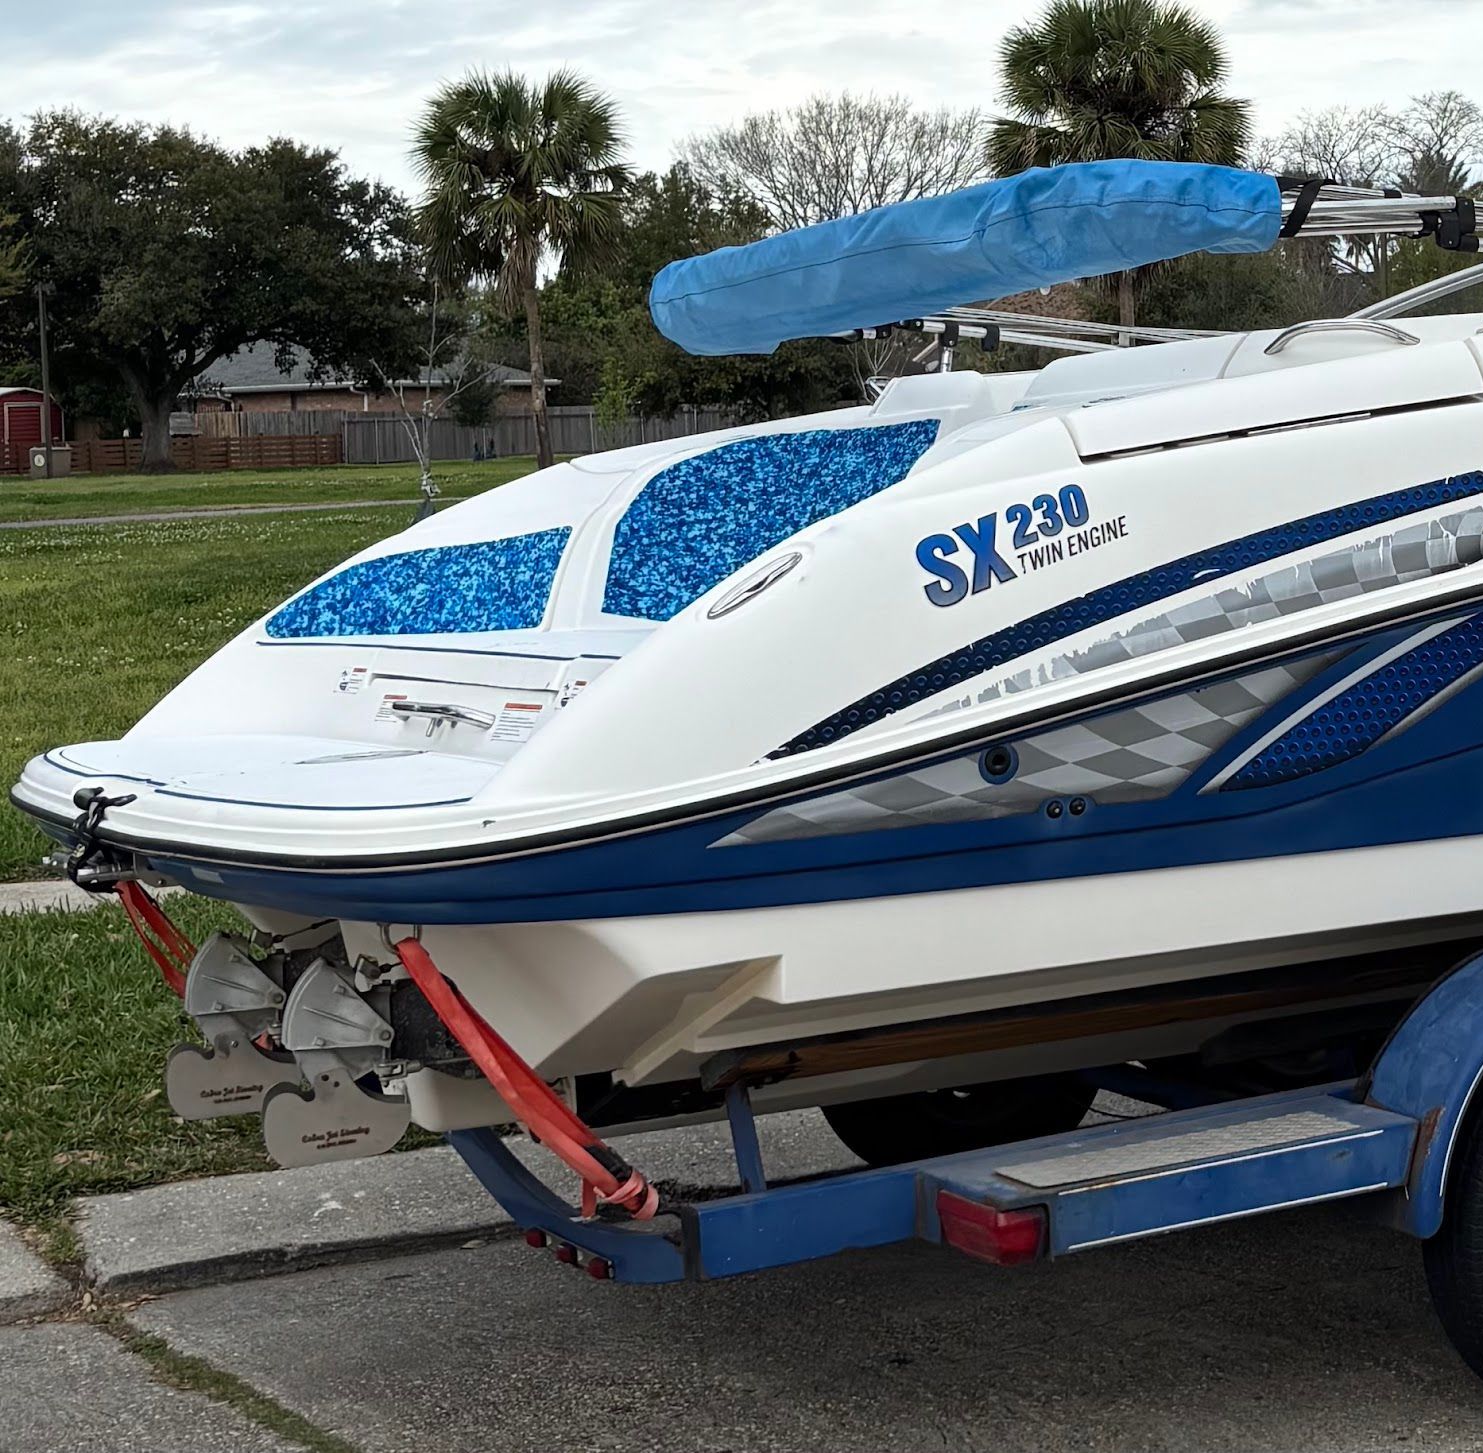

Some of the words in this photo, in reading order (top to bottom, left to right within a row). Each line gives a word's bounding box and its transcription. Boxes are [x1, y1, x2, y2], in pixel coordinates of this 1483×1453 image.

[915, 512, 1018, 607] SX
[1005, 484, 1090, 550] 230
[1017, 540, 1064, 574] TWIN
[1067, 515, 1129, 557] ENGINE
